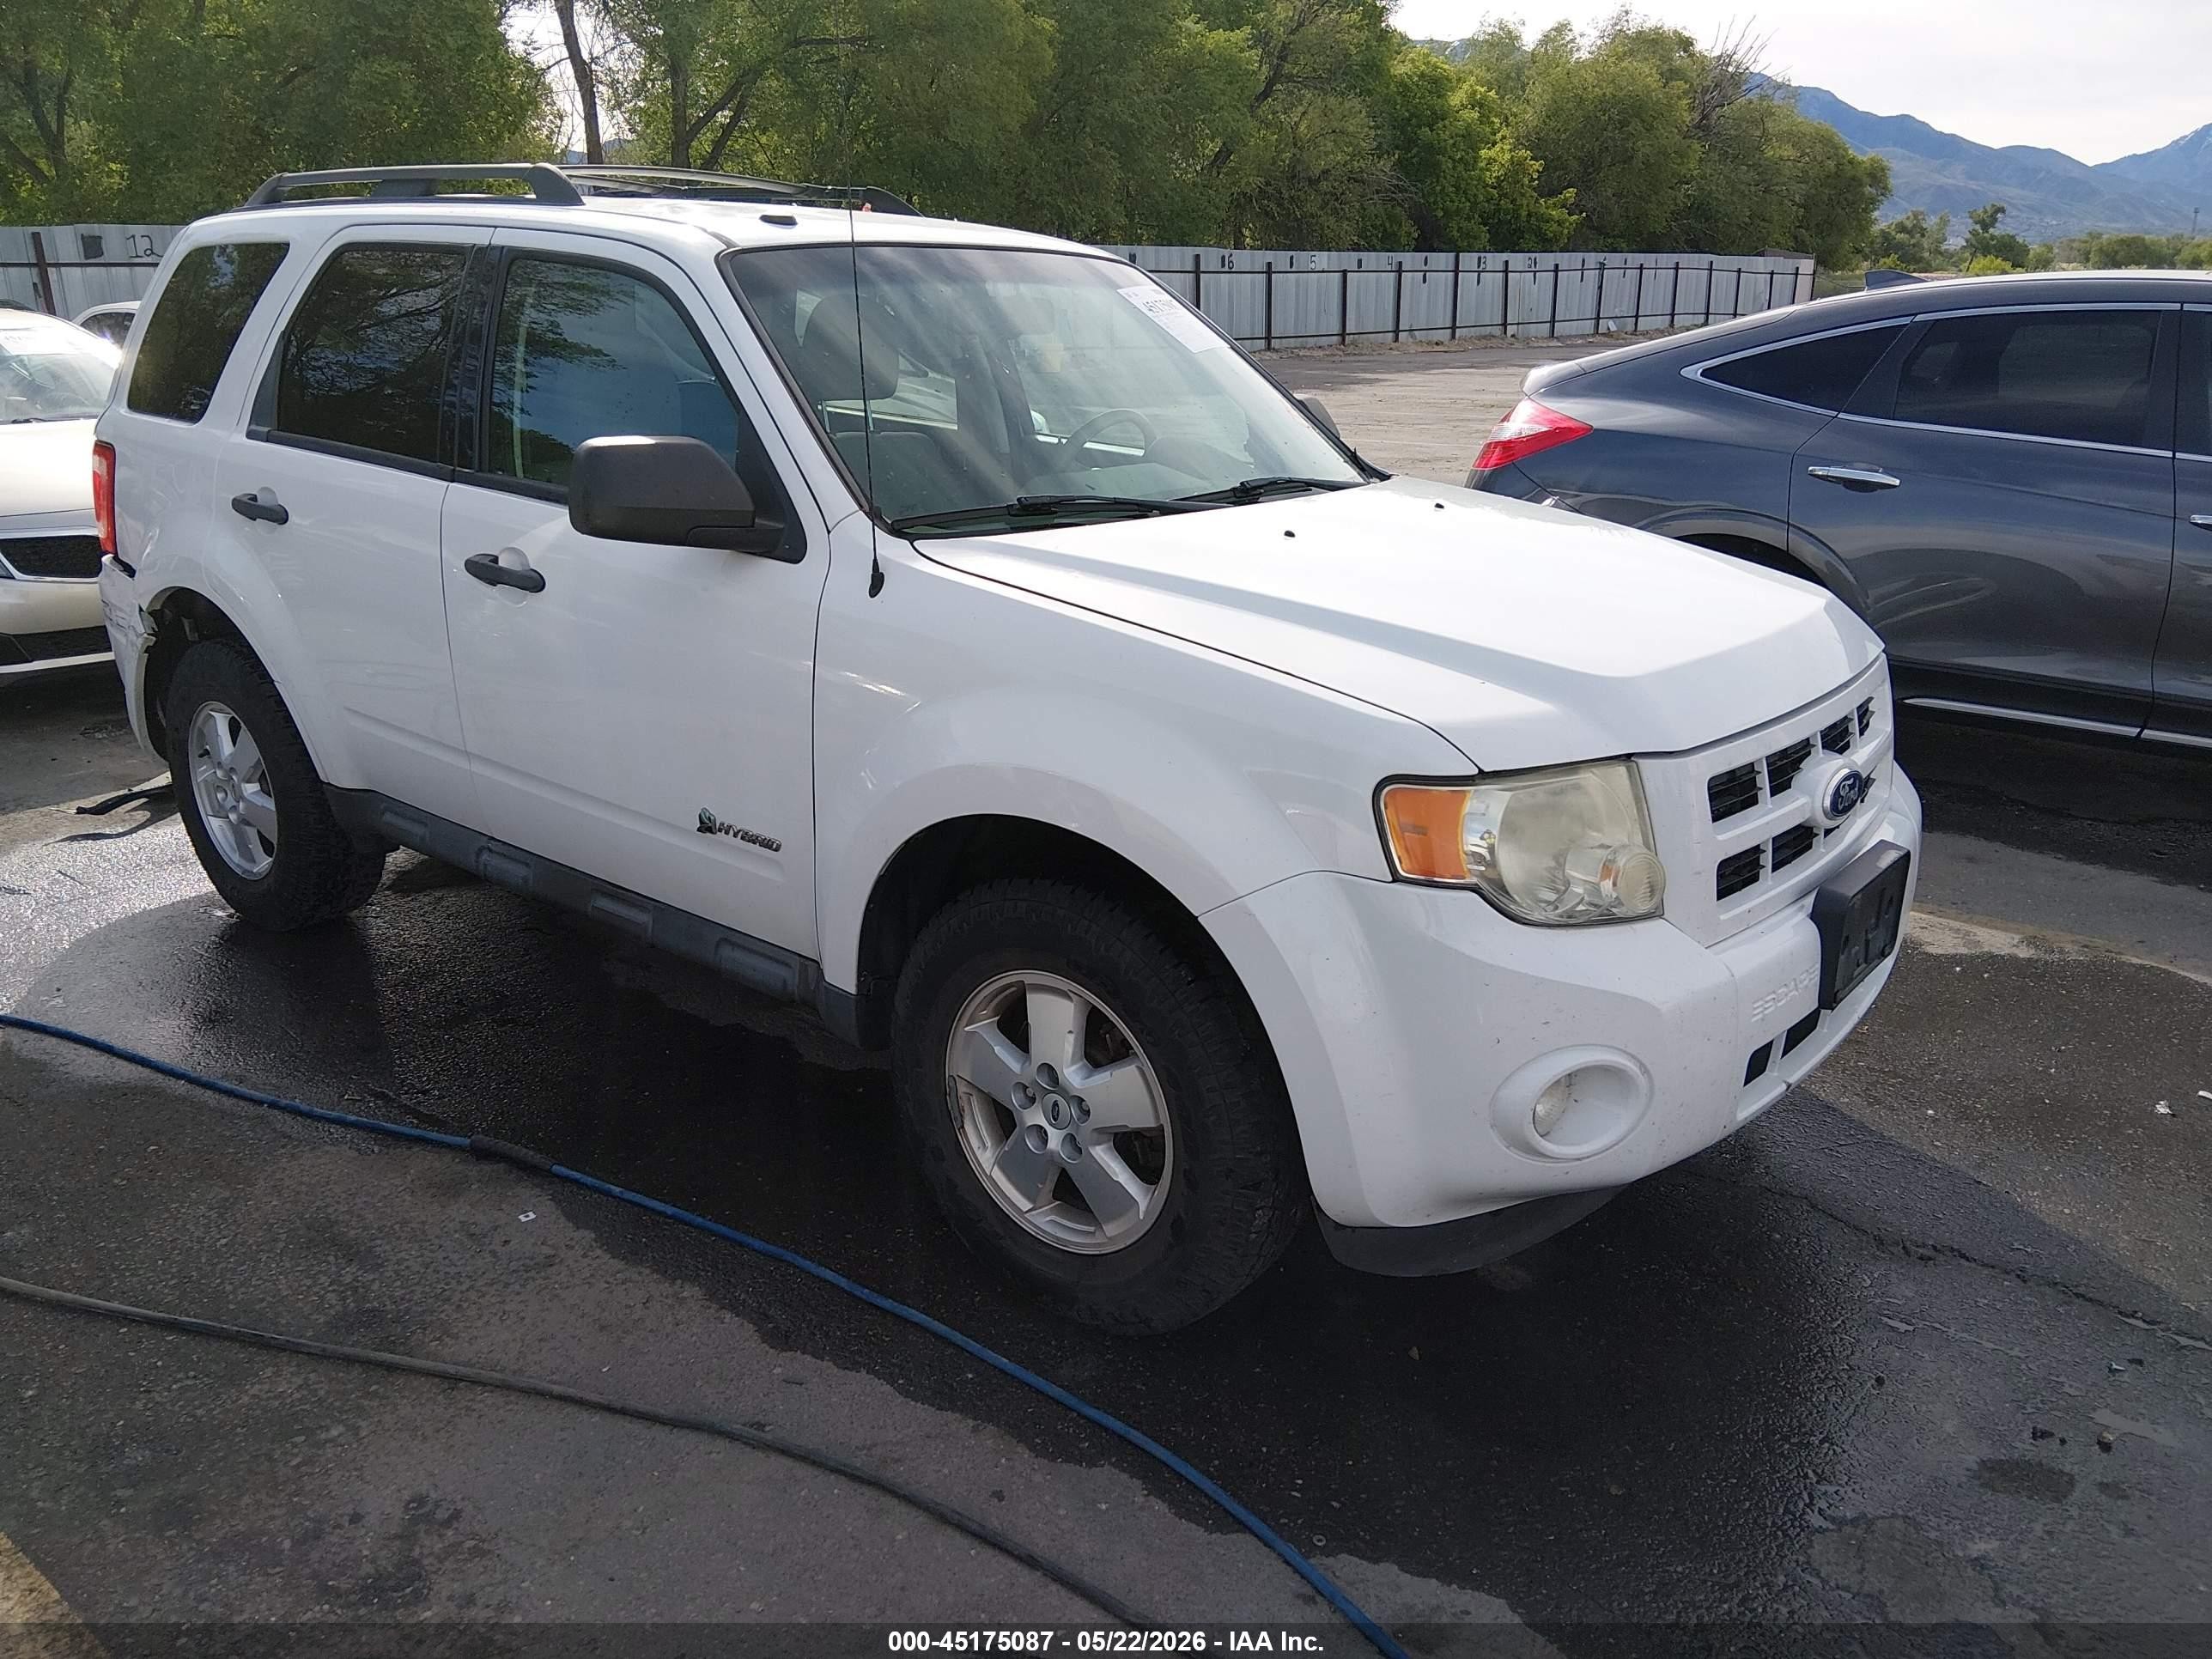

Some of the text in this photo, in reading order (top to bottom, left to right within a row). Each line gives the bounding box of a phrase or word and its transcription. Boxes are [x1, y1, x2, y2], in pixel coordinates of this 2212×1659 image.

[125, 234, 164, 258] 12
[1310, 254, 1317, 270] 5
[1387, 255, 1394, 270] 4
[1838, 776, 1859, 811] Ford
[717, 821, 782, 853] HYBRID
